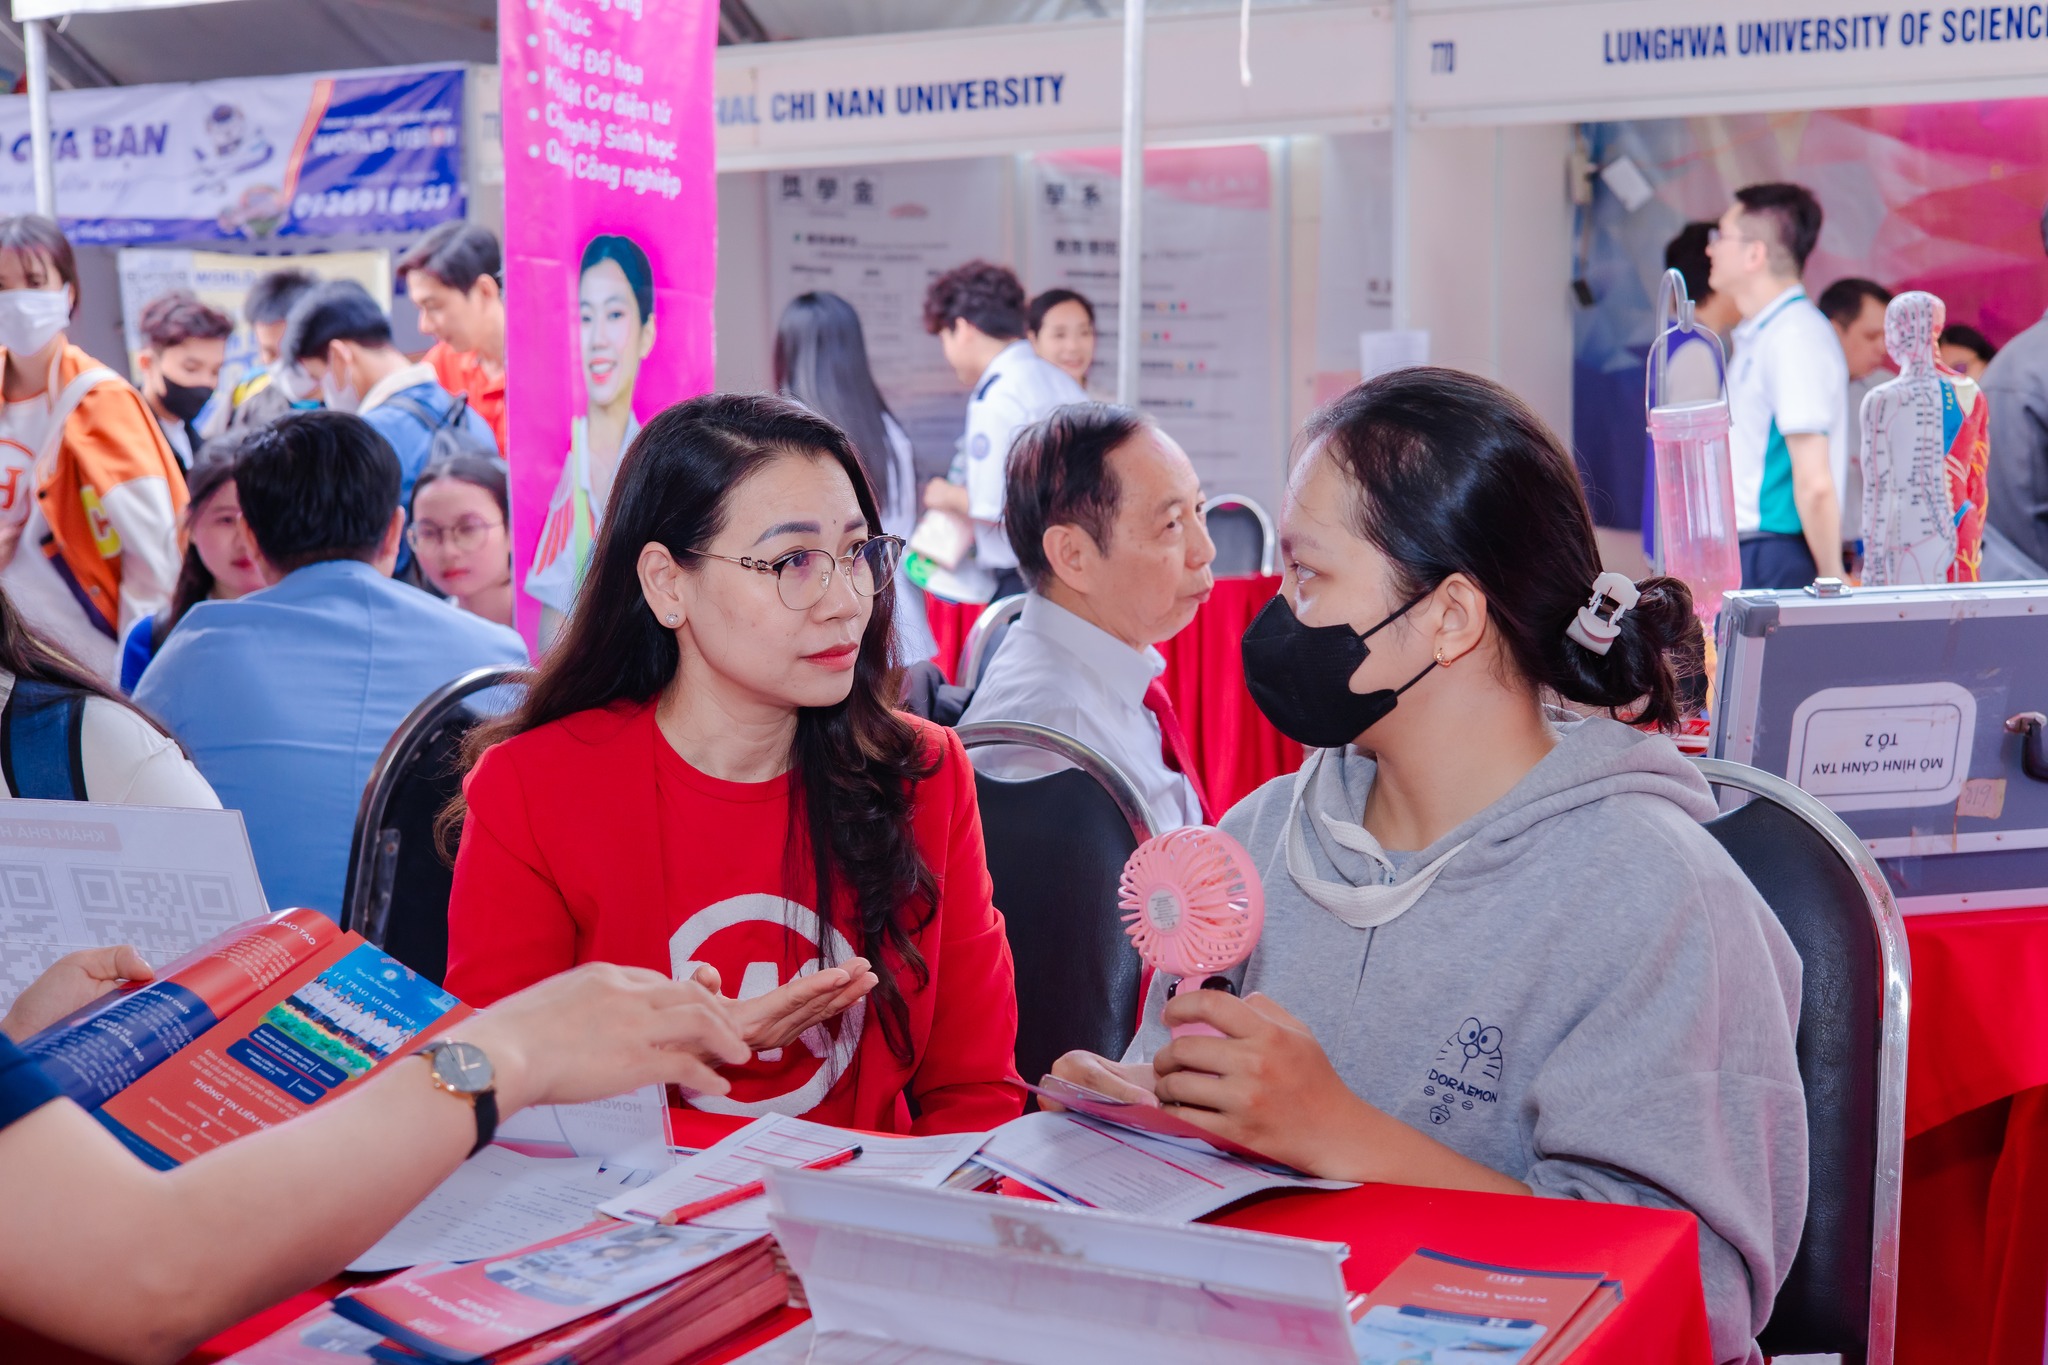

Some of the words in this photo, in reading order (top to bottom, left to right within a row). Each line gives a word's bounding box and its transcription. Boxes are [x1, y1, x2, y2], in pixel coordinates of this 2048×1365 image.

[1603, 24, 1728, 65] LUNGHWA
[1737, 13, 1890, 57] UNIVERSITY
[1900, 12, 1931, 47] OF
[613, 92, 650, 122] điện
[771, 92, 816, 122] CHI
[826, 87, 886, 119] NAN
[896, 74, 1065, 115] UNIVERSITY
[92, 124, 168, 171] BẠN
[646, 132, 678, 164] học
[575, 153, 620, 191] Công
[623, 166, 682, 201] nghiệp
[1865, 733, 1874, 747] 2
[1877, 732, 1899, 753] TỔ
[1812, 761, 1837, 775] TAY
[1841, 760, 1879, 776] CÁNH
[1883, 758, 1915, 774] HÌNH
[1919, 757, 1944, 774] MÔ
[346, 980, 368, 996] TRAO
[1428, 1068, 1499, 1103] DORAEMON
[223, 1098, 238, 1110] TIN
